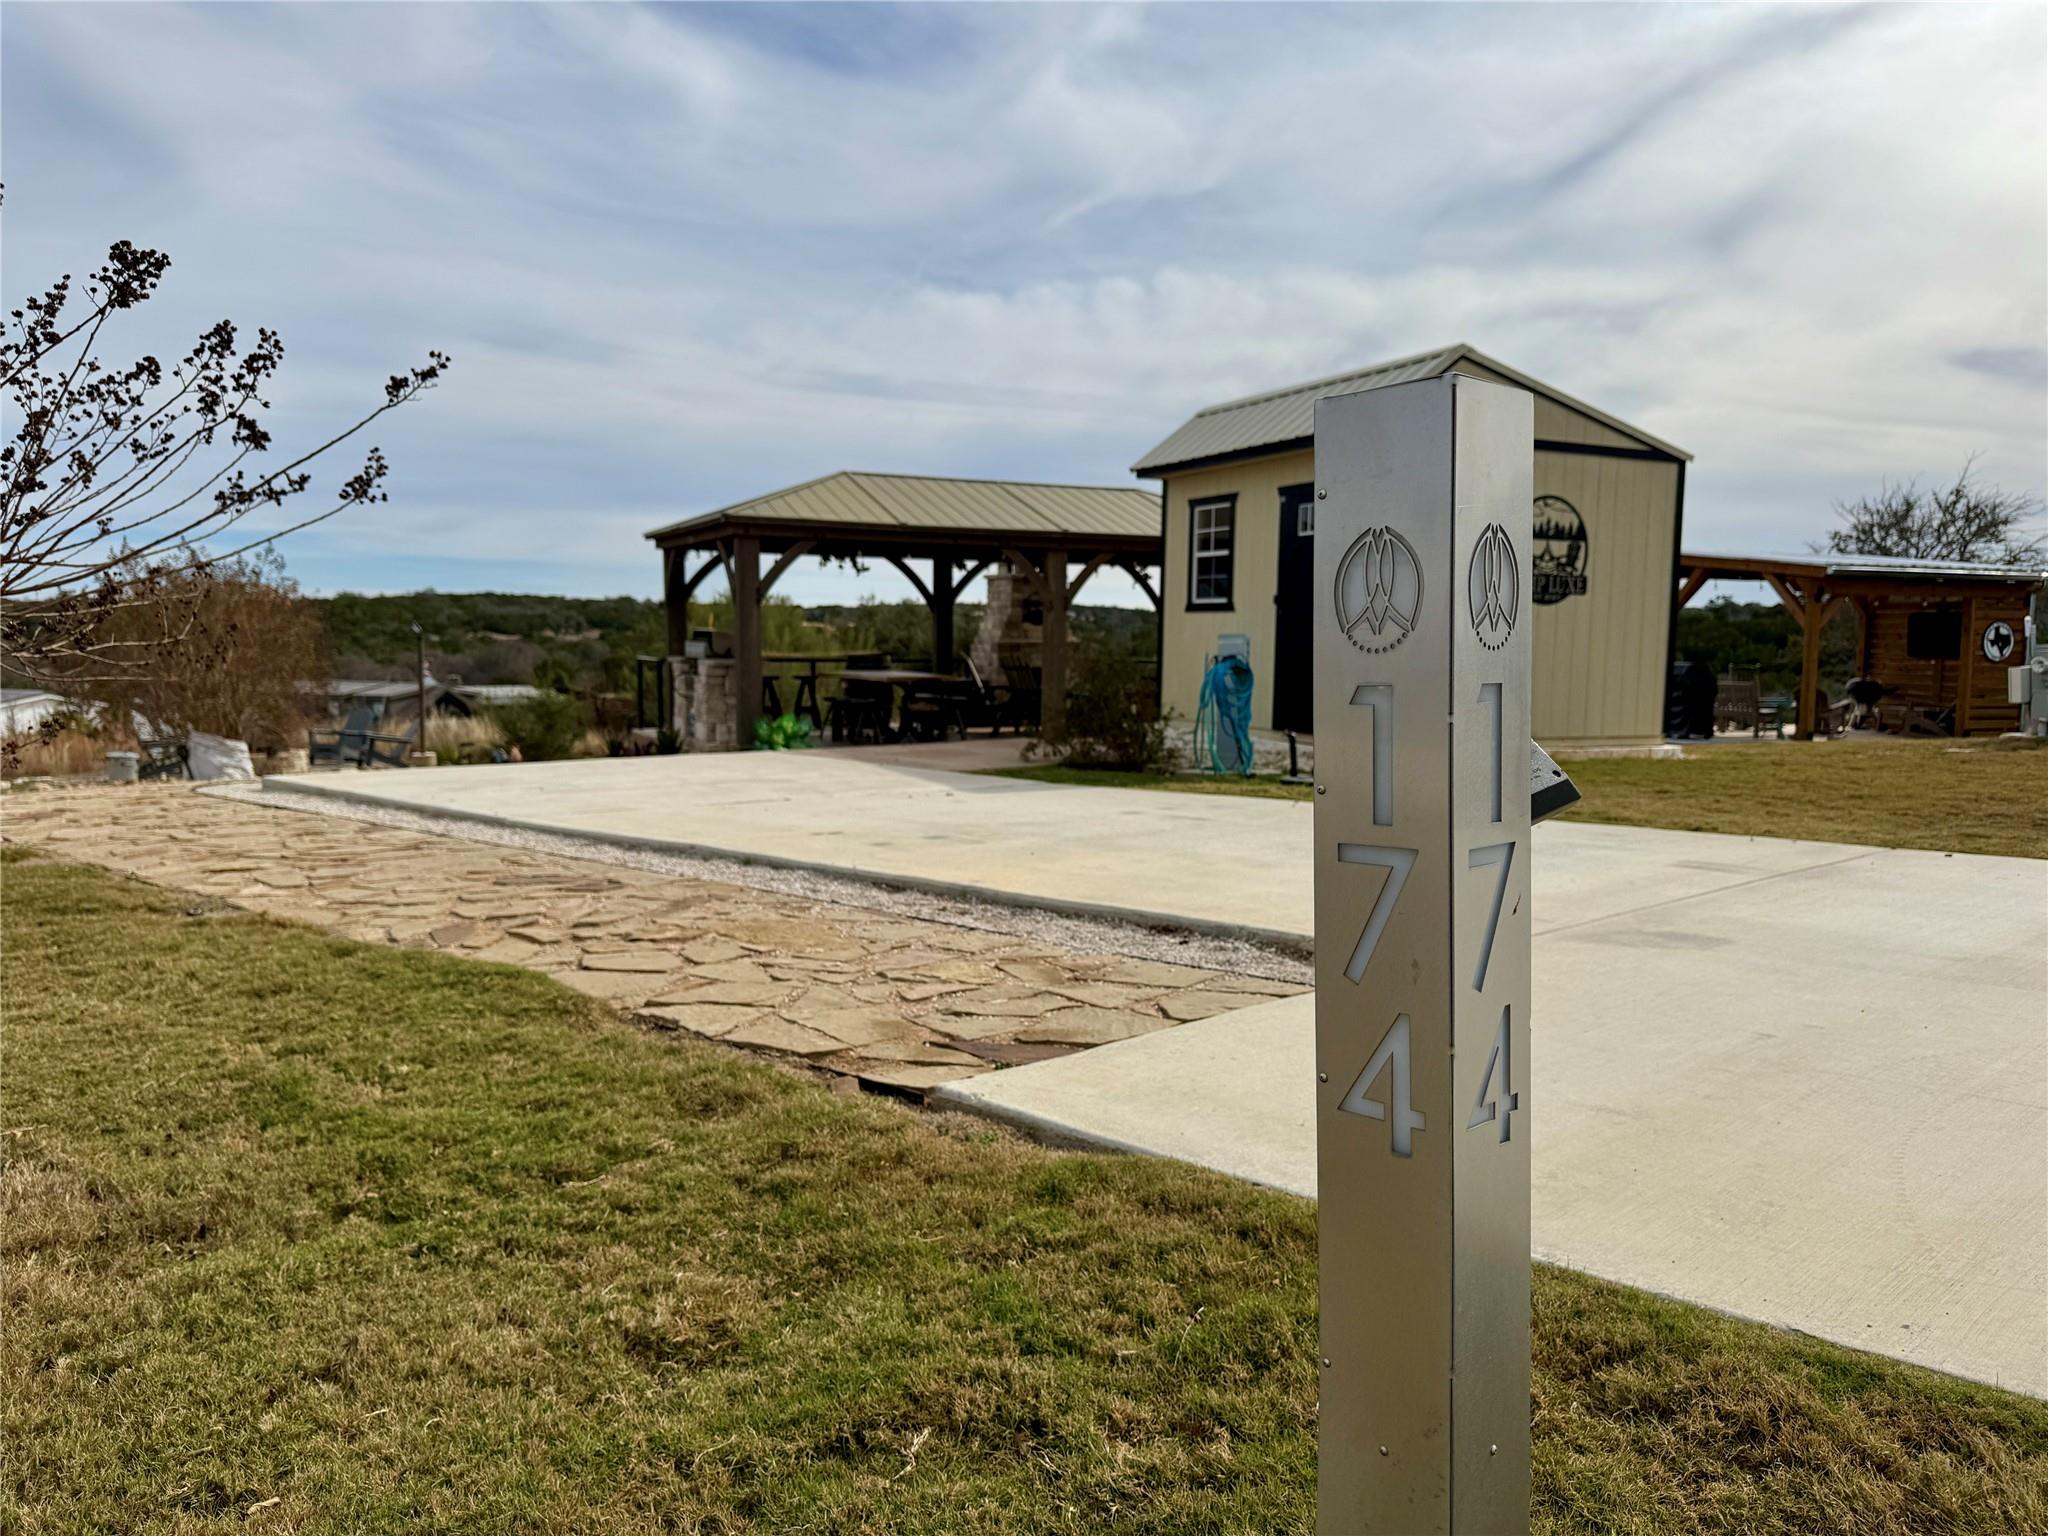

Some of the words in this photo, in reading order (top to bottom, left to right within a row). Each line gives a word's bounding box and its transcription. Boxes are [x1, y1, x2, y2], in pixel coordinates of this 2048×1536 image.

[1549, 576, 1585, 594] LUXE
[1337, 684, 1426, 1157] 174
[1466, 682, 1519, 1144] 174
